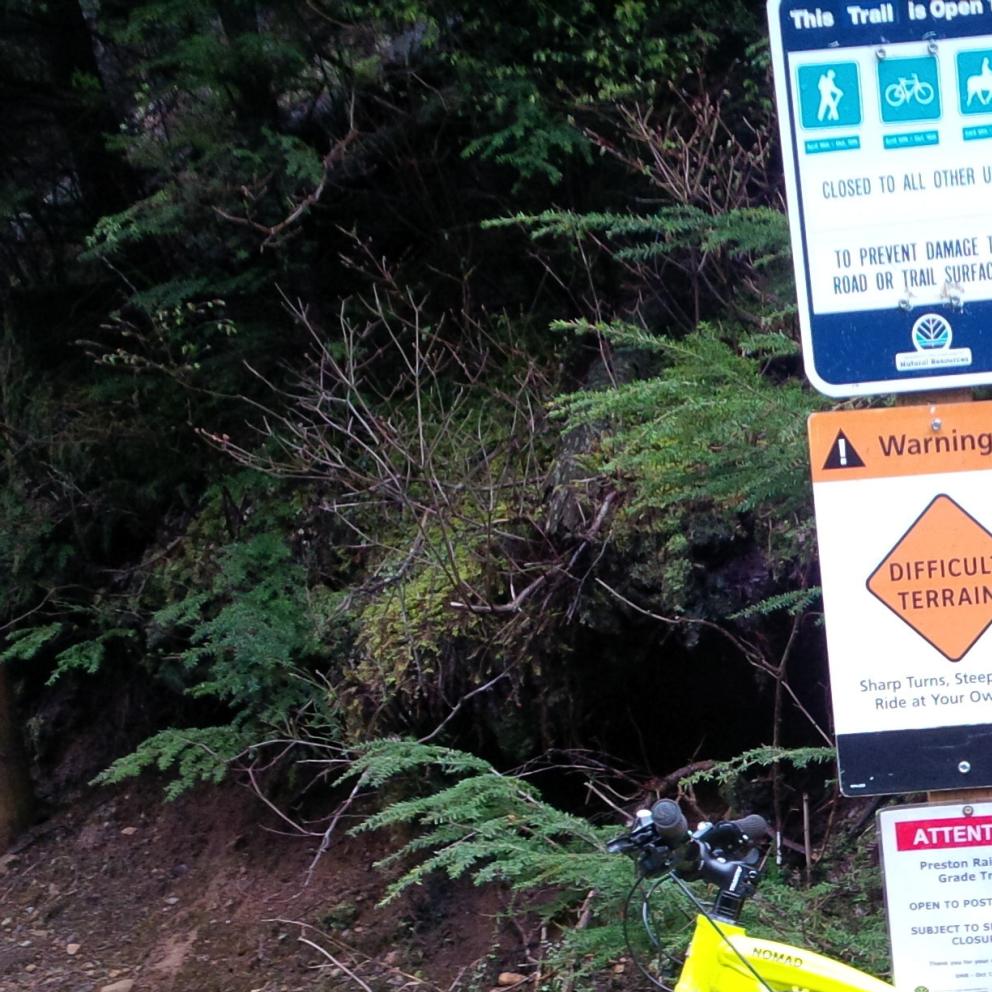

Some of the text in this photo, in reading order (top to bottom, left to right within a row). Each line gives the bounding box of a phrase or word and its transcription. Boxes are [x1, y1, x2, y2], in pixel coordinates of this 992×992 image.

[790, 8, 835, 29] This
[847, 4, 894, 25] Trail
[930, 0, 983, 20] Open
[822, 177, 872, 200] CLOSED
[879, 174, 896, 194] TO
[903, 173, 926, 192] ALL
[933, 167, 976, 189] OTHER
[834, 248, 851, 269] TO
[859, 242, 918, 267] PREVENT
[926, 236, 979, 261] DAMAGE
[833, 273, 868, 295] ROAD
[876, 271, 894, 291] OR
[903, 267, 937, 289] TRAIL
[859, 675, 902, 694] Sharp
[906, 673, 950, 690] Turns,
[875, 695, 907, 711] Ride
[912, 696, 926, 708] at
[930, 691, 964, 706] Your
[920, 859, 969, 871] Preston
[938, 871, 976, 884] Grade
[909, 900, 940, 911] OPEN
[944, 899, 959, 909] TO
[911, 924, 960, 935] SUBJECT
[964, 923, 979, 932] TO
[752, 946, 803, 969] NOMAD
